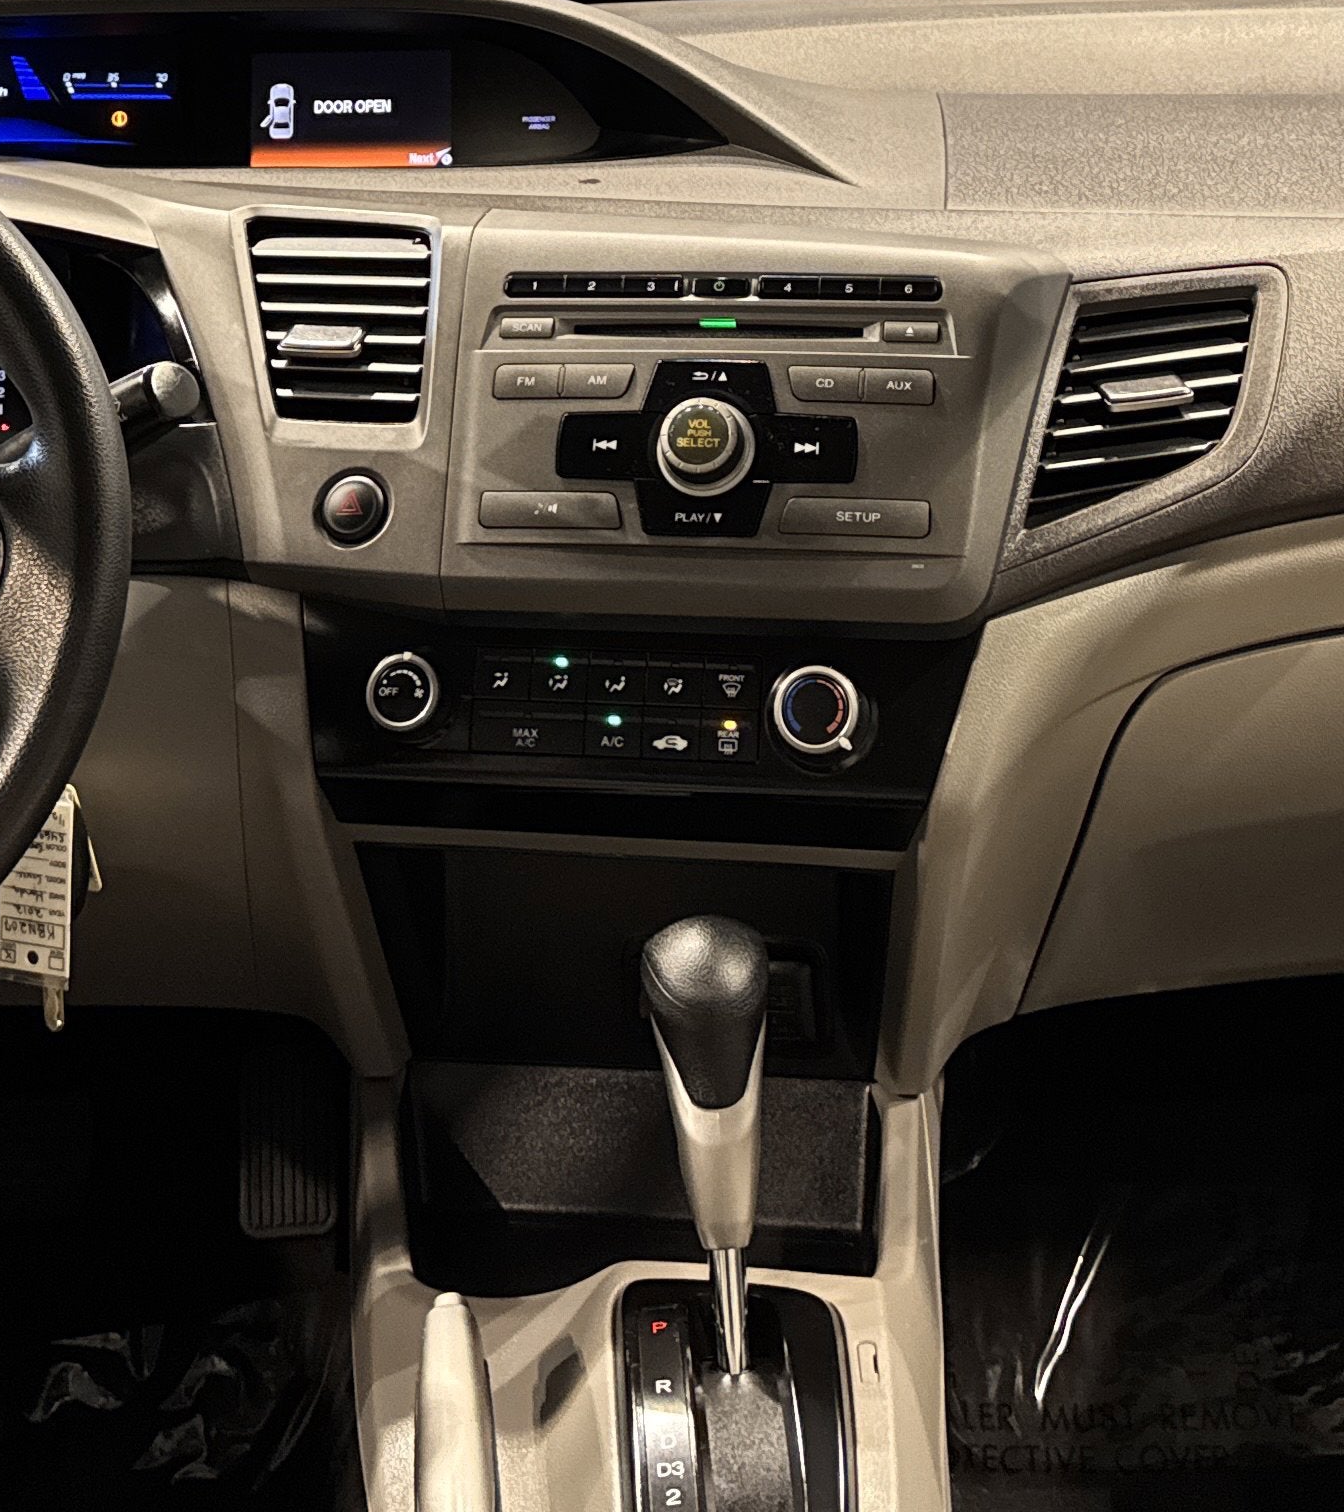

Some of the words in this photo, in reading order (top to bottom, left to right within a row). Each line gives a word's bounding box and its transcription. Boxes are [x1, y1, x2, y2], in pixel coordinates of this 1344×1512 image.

[313, 99, 353, 115] DOOR
[354, 98, 392, 114] OPEN
[408, 152, 436, 164] Next
[532, 281, 539, 291] 1
[587, 281, 597, 291] 2
[646, 281, 656, 292] 3
[783, 282, 793, 292] 4
[844, 283, 854, 293] 5
[904, 284, 913, 294] 6
[511, 323, 543, 332] SCAN
[516, 376, 536, 386] FM
[587, 375, 608, 385] AM
[815, 378, 834, 388] CD
[885, 380, 912, 391] AUX
[687, 418, 711, 429] VOL
[686, 429, 712, 437] PUSH
[676, 437, 721, 448] SELECT
[835, 510, 881, 523] SETUP
[718, 673, 746, 682] FRONT
[378, 687, 399, 697] OFF
[512, 728, 539, 738] MAX
[717, 730, 740, 739] REAR
[515, 738, 537, 748] A/C
[600, 736, 625, 748] A/C
[16, 904, 44, 919] 2012
[4, 919, 55, 940] KBN207
[651, 1321, 668, 1334] P
[655, 1379, 672, 1394] R
[660, 1435, 677, 1450] D
[656, 1460, 685, 1478] D3
[665, 1488, 682, 1506] 2
